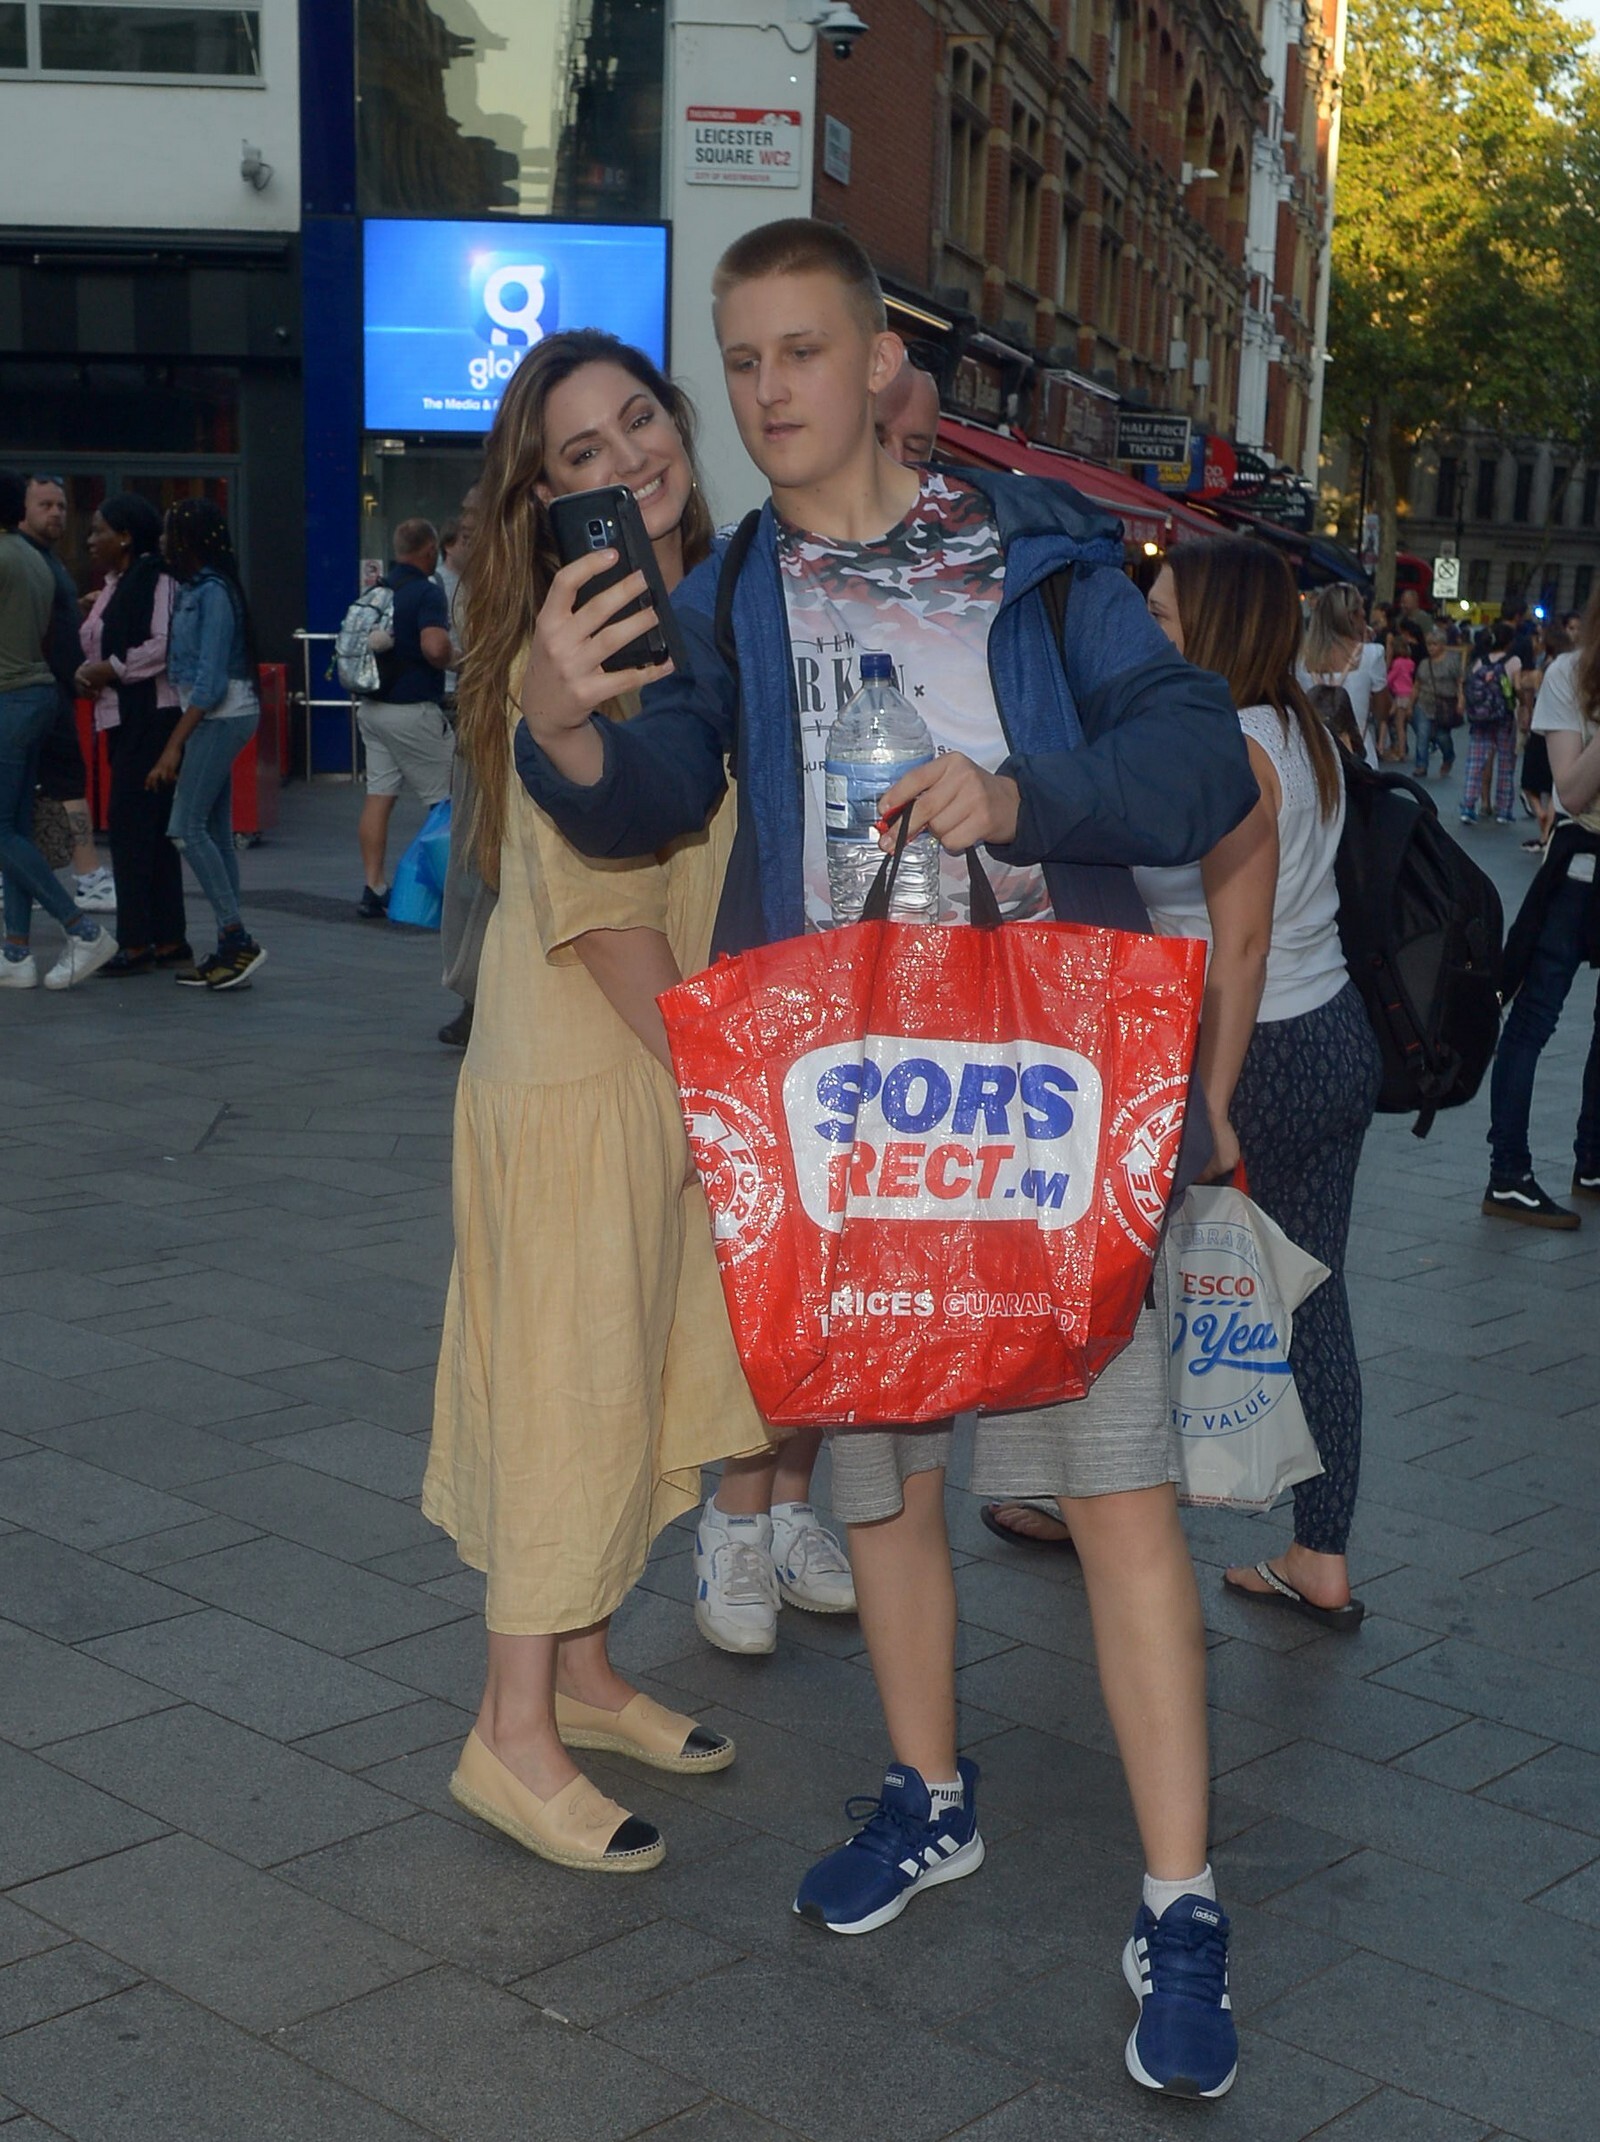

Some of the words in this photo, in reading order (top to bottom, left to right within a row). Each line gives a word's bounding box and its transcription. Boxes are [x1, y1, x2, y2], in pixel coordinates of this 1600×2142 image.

[695, 128, 773, 147] LEICESTER
[695, 147, 754, 165] SQUARE
[759, 151, 791, 166] WC2
[422, 397, 443, 410] The
[445, 398, 480, 411] Media
[482, 399, 491, 410] &
[1121, 422, 1151, 435] HALF
[1153, 424, 1185, 437] PRICE
[1129, 443, 1175, 457] TICKETS
[816, 632, 855, 654] NEW
[1127, 1090, 1149, 1111] THE
[739, 1103, 763, 1126] THIS
[1178, 1271, 1255, 1297] ESCO
[1203, 1390, 1271, 1430] VALUE
[930, 1788, 963, 1802] PUM
[1195, 1910, 1218, 1924] adidas
